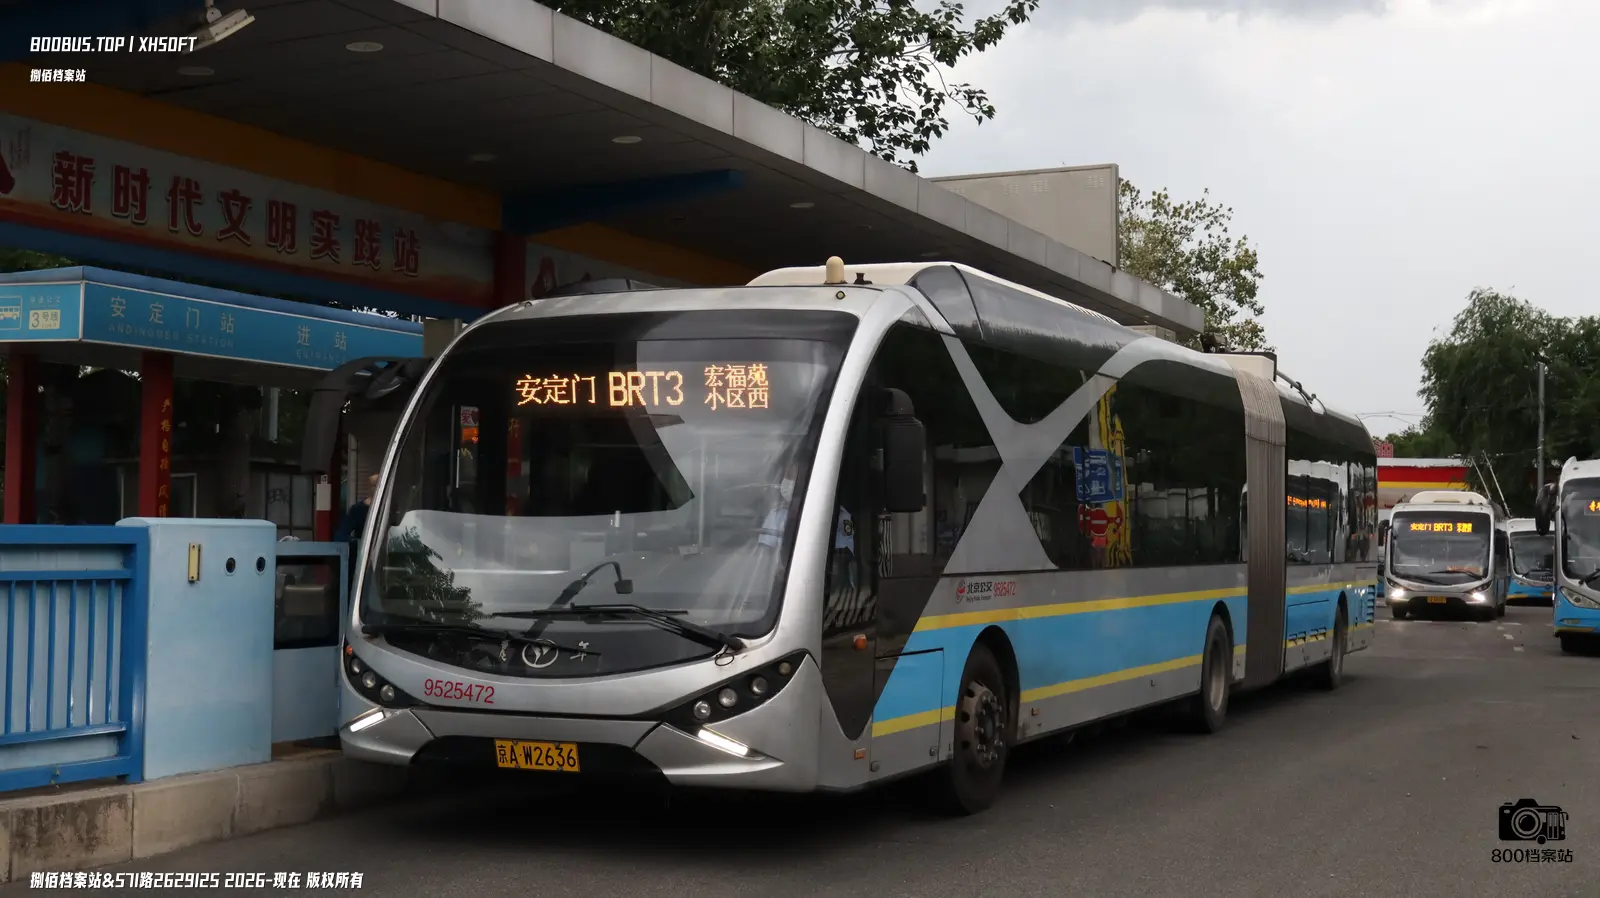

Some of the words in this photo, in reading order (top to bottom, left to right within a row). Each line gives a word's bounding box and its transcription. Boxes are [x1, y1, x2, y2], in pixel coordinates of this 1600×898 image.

[51, 150, 421, 276] 新时代文明实践站
[110, 296, 235, 335] 安定门站
[296, 325, 348, 351] 进站
[703, 364, 770, 386] 宏福苑
[515, 373, 596, 407] 安定门
[608, 371, 685, 408] BRT3
[703, 386, 770, 411] 小区西
[966, 581, 993, 594] 北京公交
[423, 678, 496, 705] 9525472
